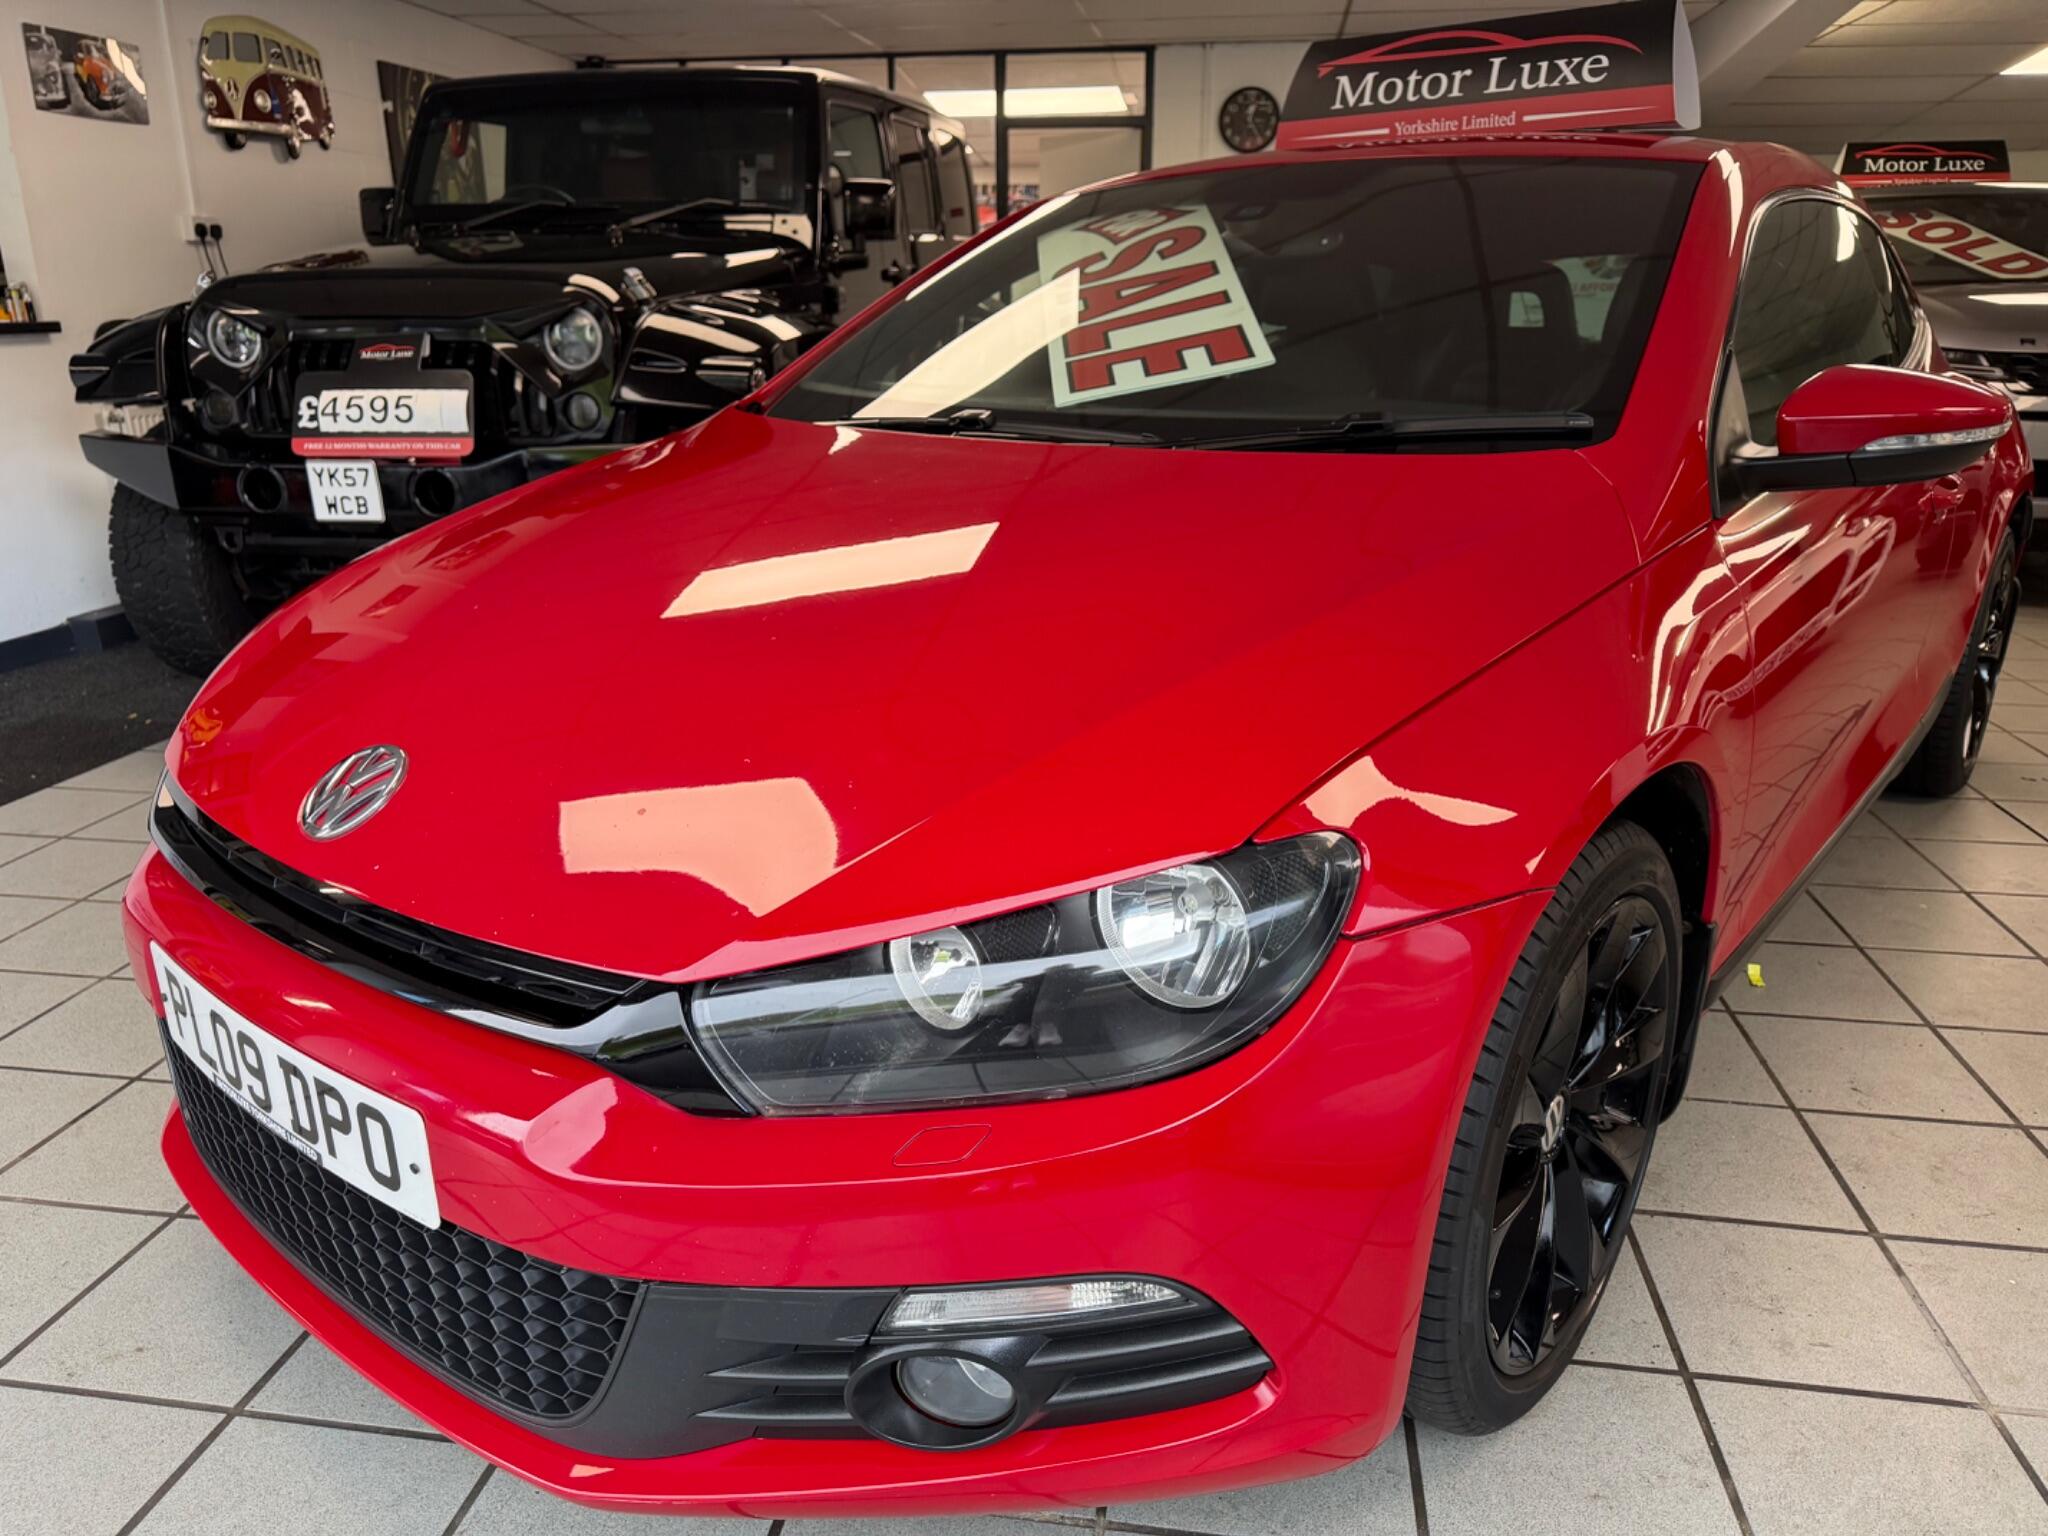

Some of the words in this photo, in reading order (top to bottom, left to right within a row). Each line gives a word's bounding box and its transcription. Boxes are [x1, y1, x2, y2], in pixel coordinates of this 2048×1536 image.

[1331, 66, 1473, 110] Motor
[1484, 52, 1611, 95] Luxe
[1394, 118, 1458, 137] Yorkshire
[1461, 111, 1516, 130] Limited
[1864, 158, 1929, 173] Motor
[1933, 156, 1986, 172] Luxe
[1876, 208, 2048, 275] SOLD
[1052, 224, 1256, 394] SALE
[298, 395, 414, 429] £4595
[312, 467, 370, 488] YK57
[325, 495, 370, 516] WCB
[164, 966, 273, 1114] PL09
[277, 1055, 401, 1193] DPO
